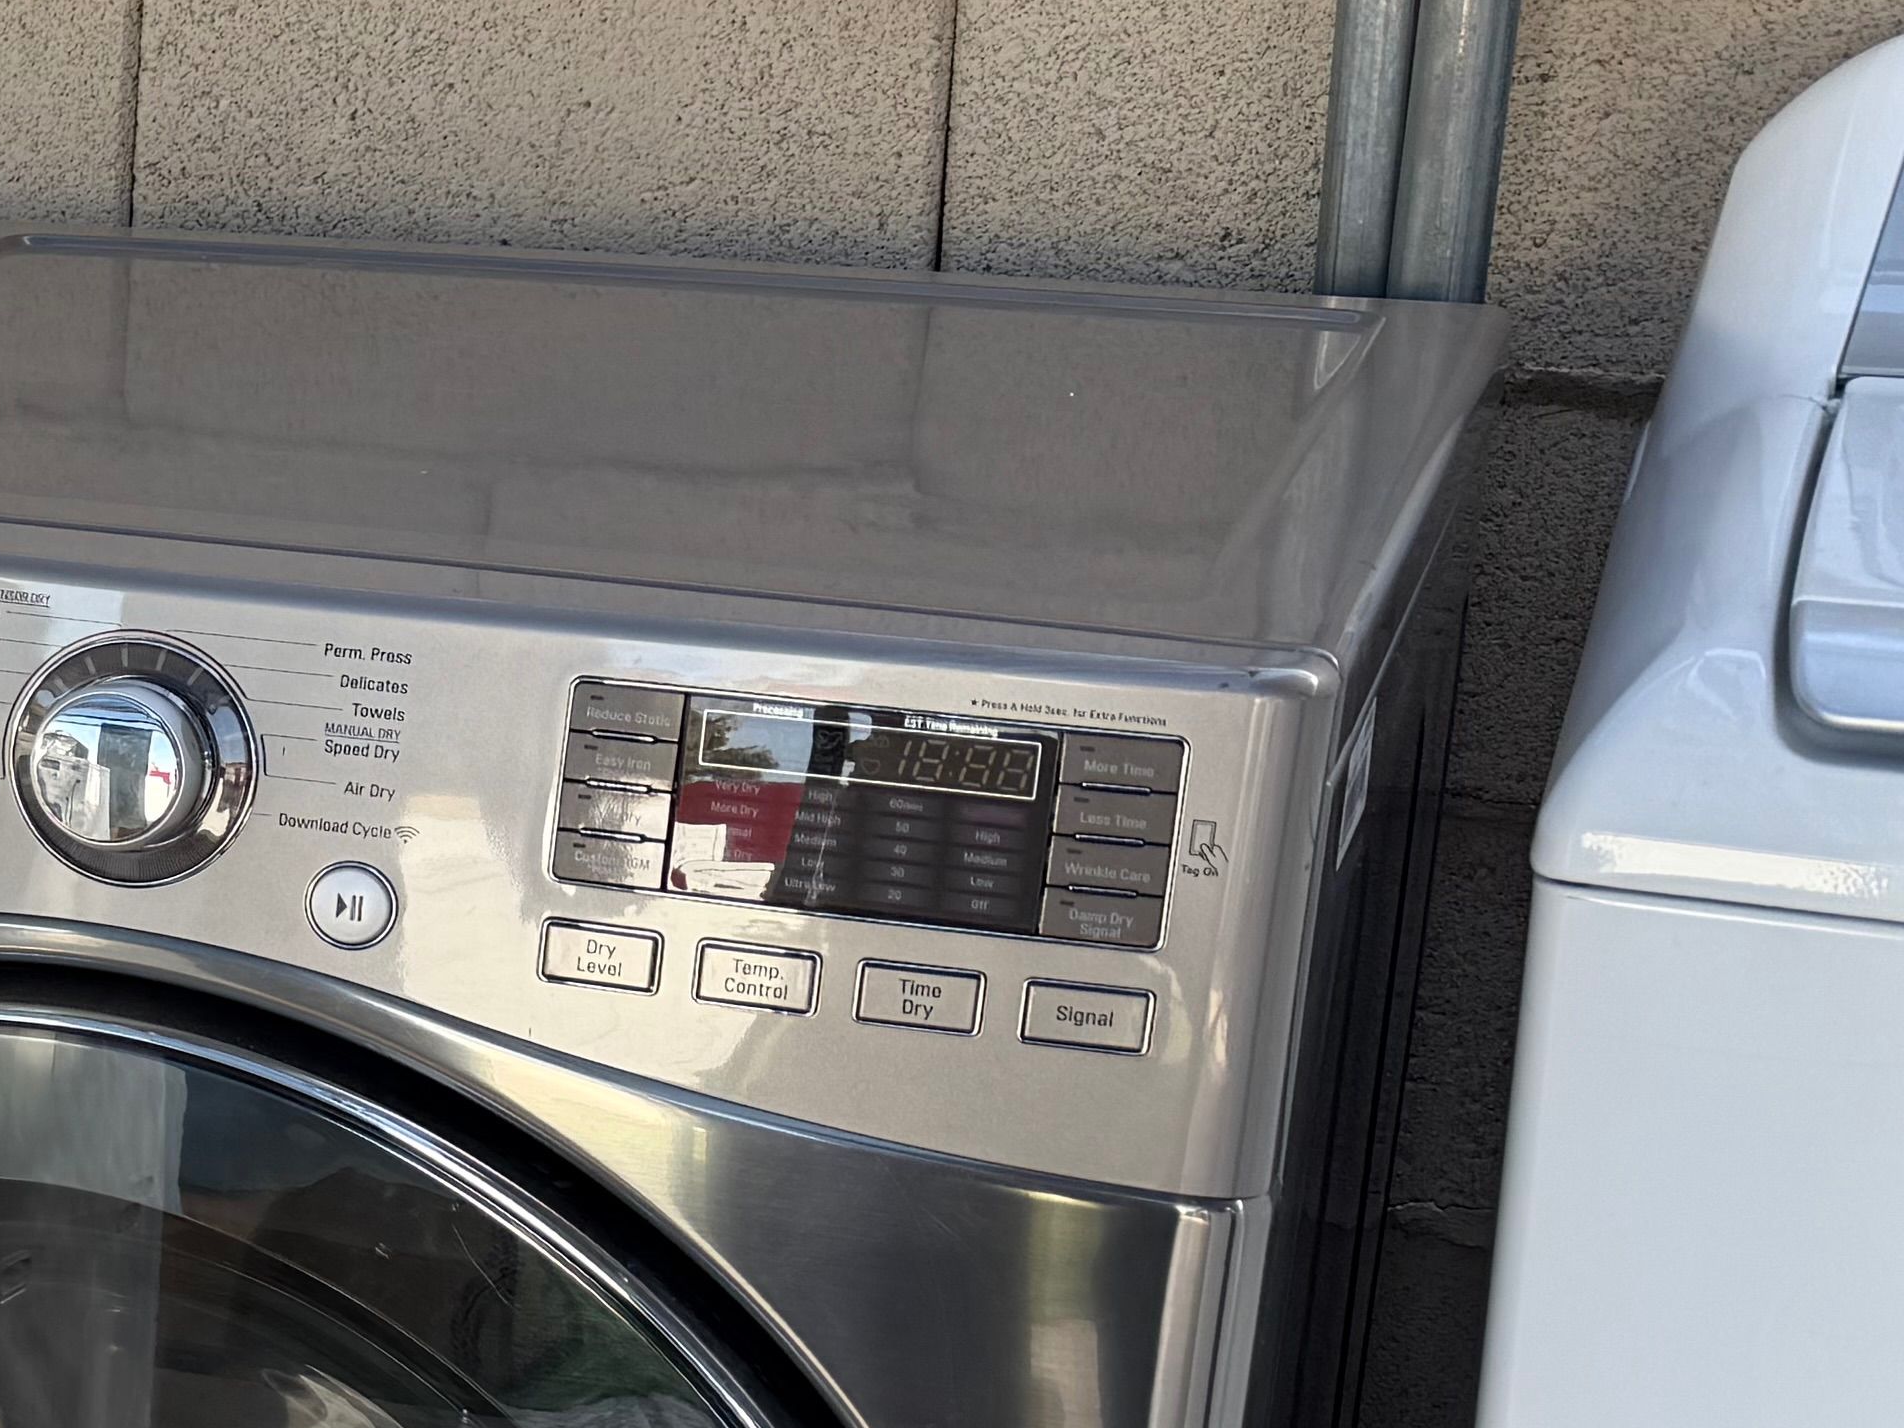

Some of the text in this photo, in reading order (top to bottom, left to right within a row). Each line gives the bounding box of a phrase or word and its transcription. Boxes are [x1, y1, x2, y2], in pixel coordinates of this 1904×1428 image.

[324, 642, 412, 665] Perm. Press
[340, 674, 409, 694] Delicates
[352, 702, 406, 722] Towels
[586, 706, 671, 727] Reduce Static
[753, 703, 805, 719] Processing
[981, 698, 1008, 711] Press
[1020, 703, 1043, 714] Hold
[1073, 707, 1087, 719] for
[1089, 709, 1116, 721] Extra
[1118, 711, 1168, 727] Functions
[324, 722, 401, 741] MANUAL DRY
[926, 718, 948, 733] Time
[949, 721, 998, 738] Remaining
[324, 739, 400, 763] Speed Dry
[595, 753, 652, 770] Easy Iron
[1083, 759, 1155, 778] More Time
[343, 781, 396, 802] Air Dry
[715, 779, 761, 796] Very Dry
[808, 790, 833, 804] High
[711, 801, 759, 818] More Dry
[795, 810, 841, 826] Mid High
[279, 812, 392, 840] Download Cycle
[895, 821, 909, 833] 50
[1079, 811, 1147, 830] Less Time
[794, 833, 837, 848] Medium
[975, 830, 1001, 845] High
[894, 844, 907, 856] 40
[963, 851, 1008, 867] Medium
[890, 866, 905, 878] 30
[1064, 861, 1151, 884] Wrinkle Care
[1181, 863, 1200, 878] Tag
[784, 877, 810, 890] Ultra
[969, 875, 995, 889] Low
[887, 888, 902, 900] 20
[970, 898, 991, 910] Off
[1068, 907, 1134, 928] Damp Dry
[1080, 923, 1122, 940] Signal
[586, 938, 617, 960] Dry
[576, 956, 623, 978] Level
[732, 958, 785, 981] Temp.
[723, 977, 789, 1002] Control
[898, 977, 942, 999] Time
[902, 999, 933, 1021] Dry
[1055, 1004, 1115, 1029] Signal
